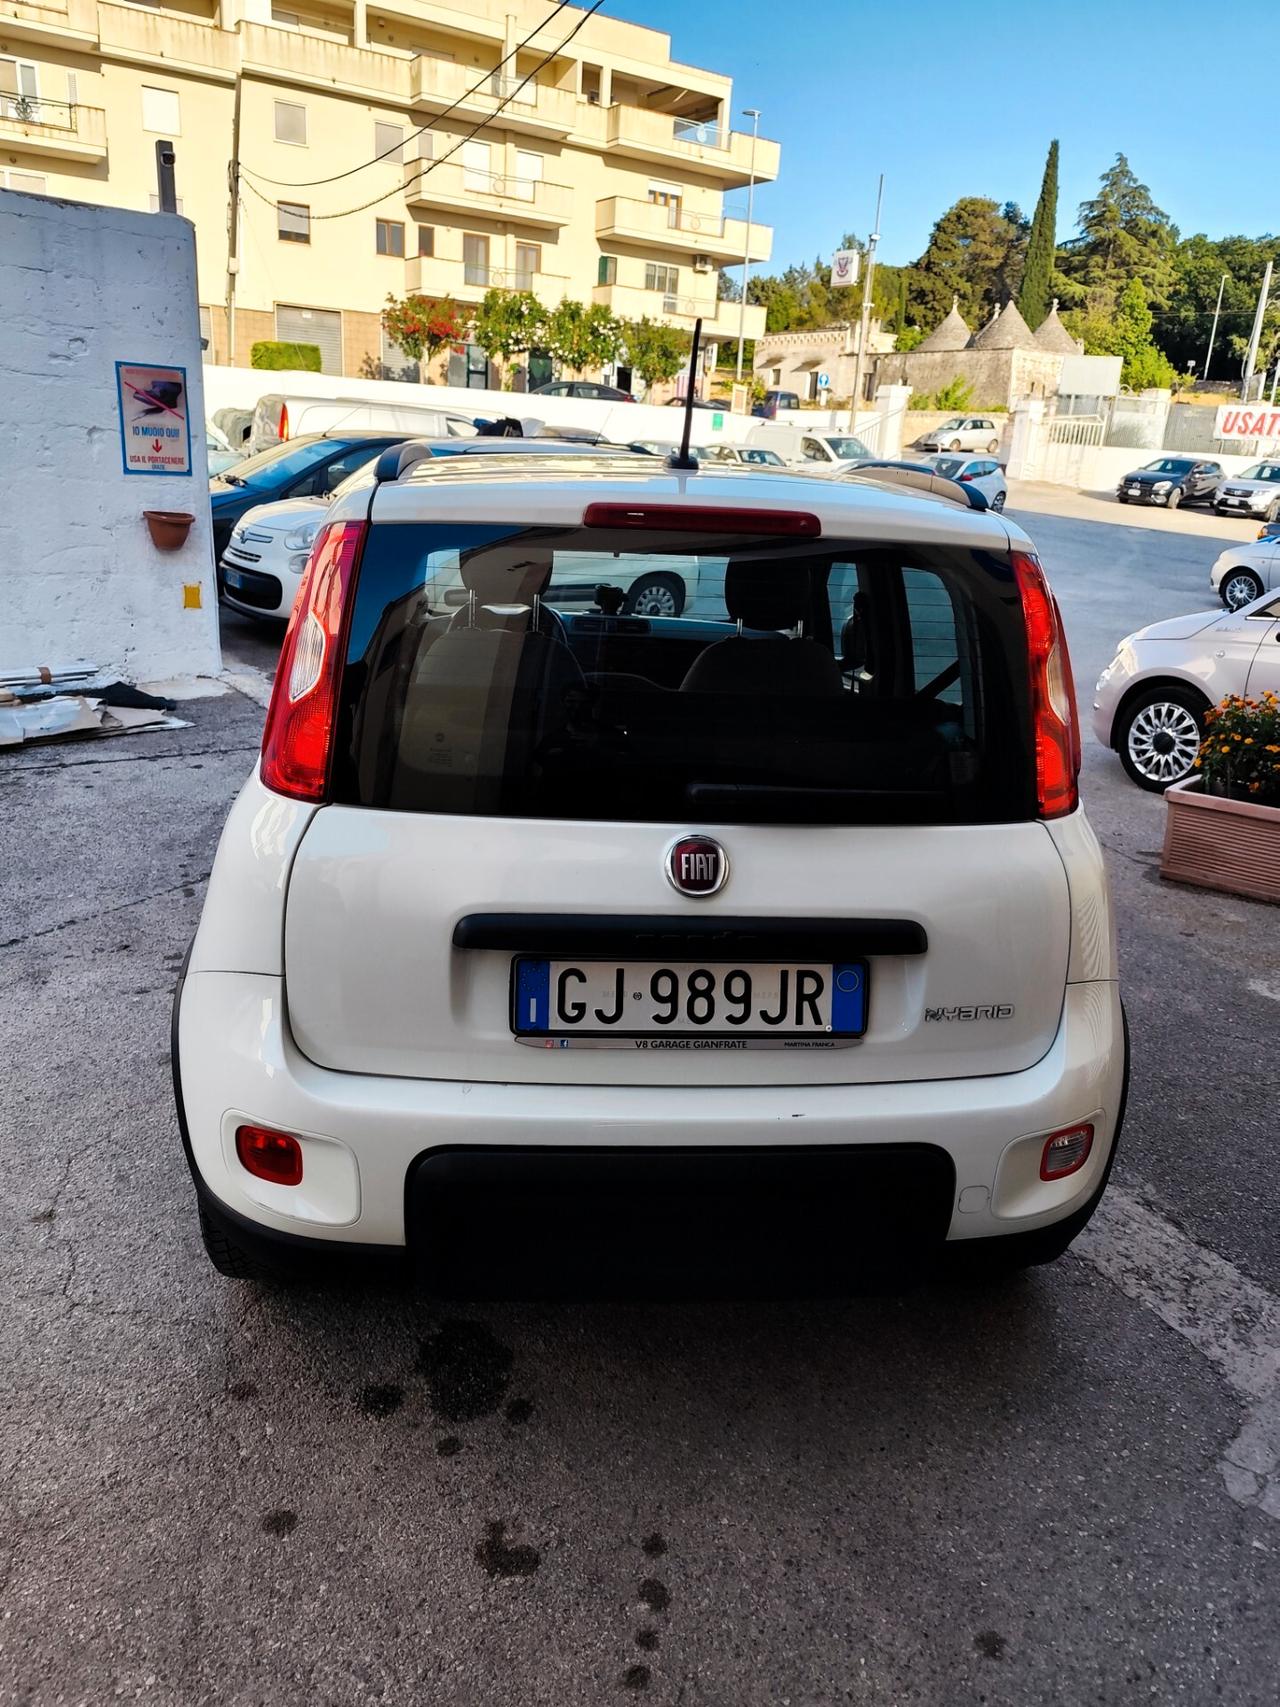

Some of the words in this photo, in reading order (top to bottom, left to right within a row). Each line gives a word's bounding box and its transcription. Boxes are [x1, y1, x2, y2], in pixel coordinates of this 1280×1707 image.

[1222, 411, 1280, 436] USAT
[130, 455, 141, 463] USA
[681, 853, 716, 880] FIAT
[635, 1040, 648, 1049] V8
[650, 1040, 691, 1049] GARAGE
[693, 1040, 748, 1049] GIANFRATE
